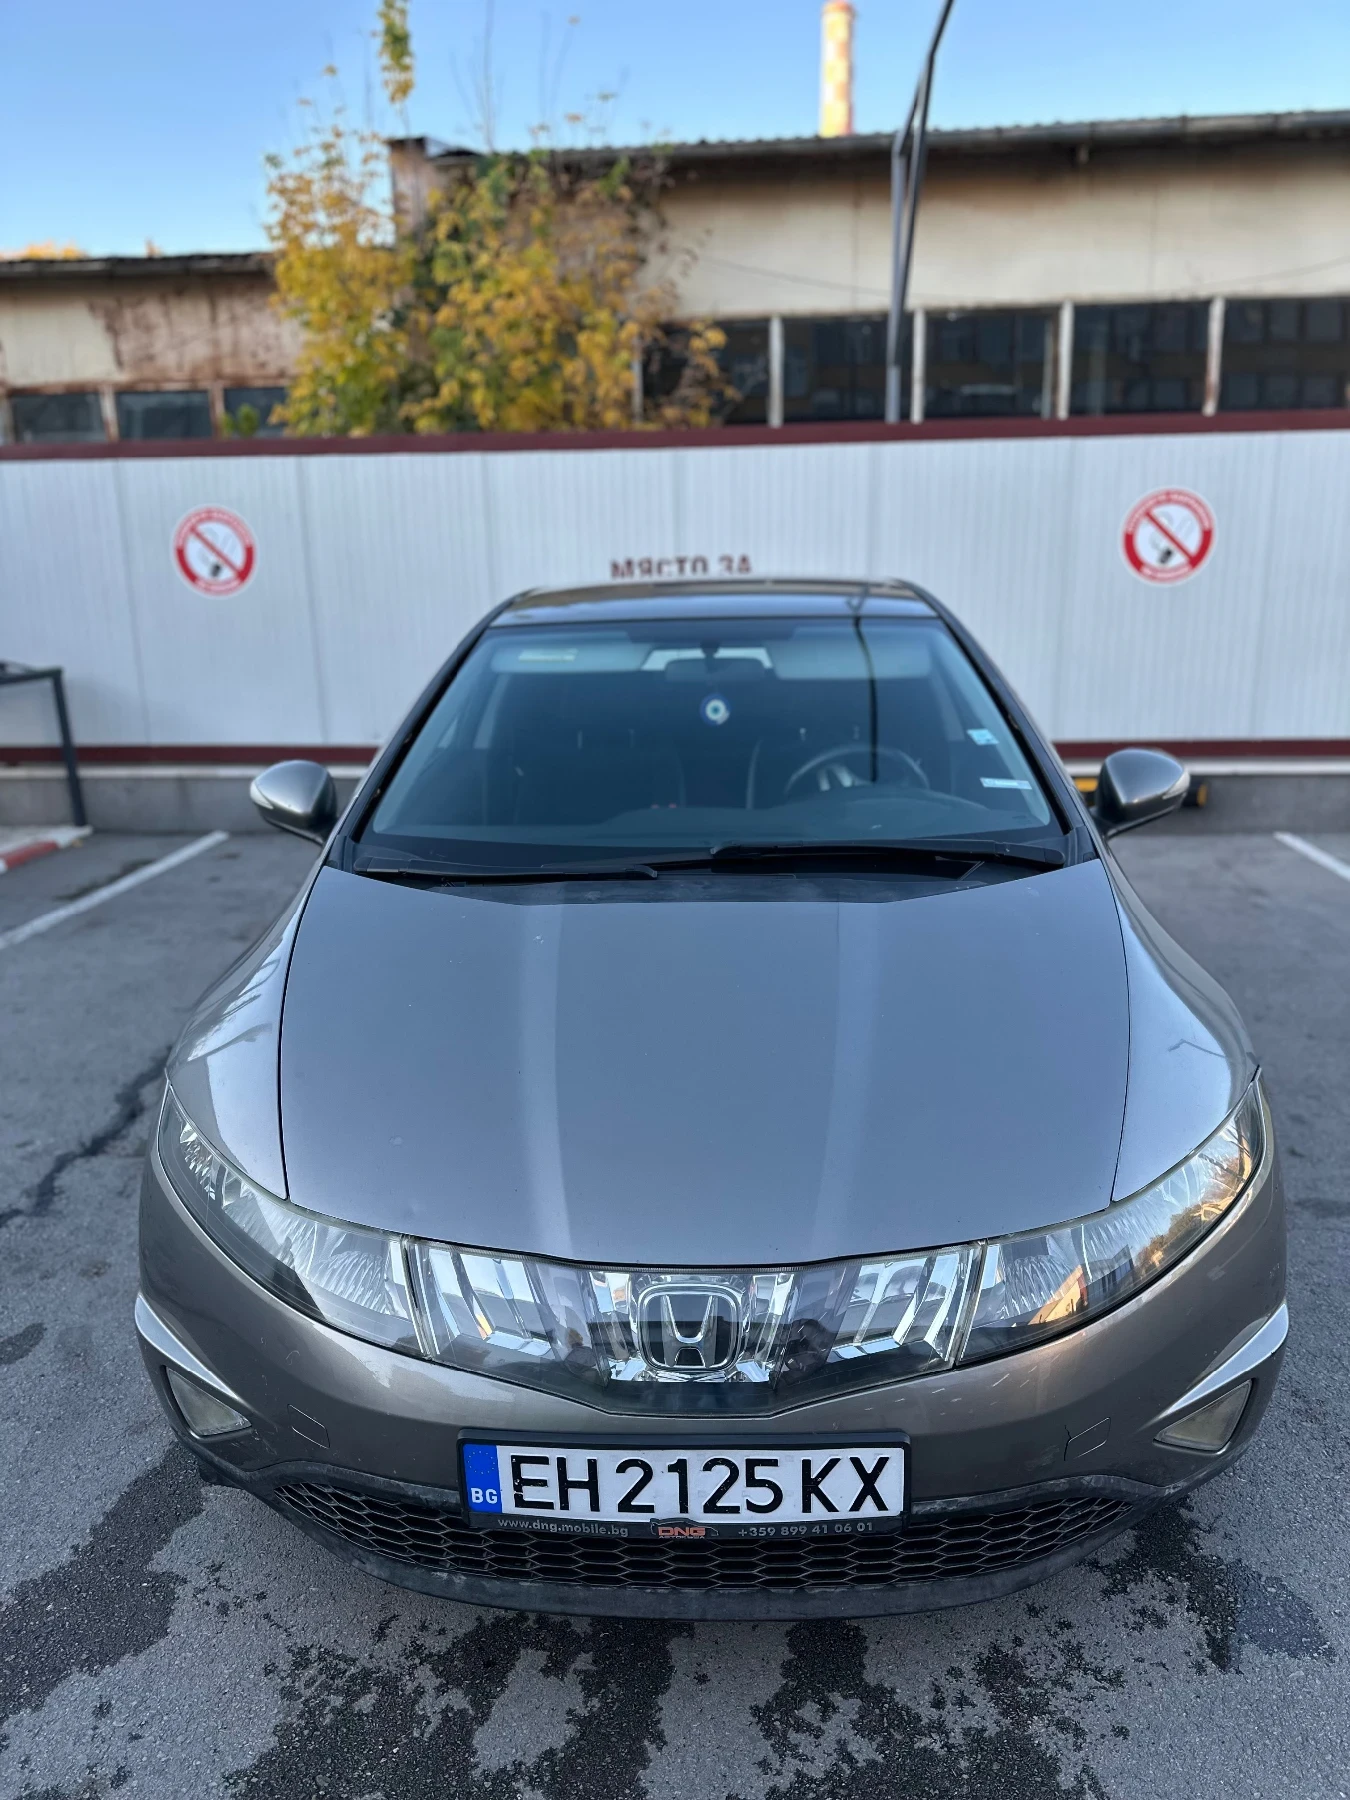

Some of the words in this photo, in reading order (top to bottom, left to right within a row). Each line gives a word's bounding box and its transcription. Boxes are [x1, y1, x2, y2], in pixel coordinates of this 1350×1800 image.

[616, 1458, 783, 1513] 2125
[471, 1488, 498, 1504] BG
[498, 1519, 628, 1537] www.dng.mobile.bg
[658, 1527, 706, 1536] DNG
[739, 1527, 776, 1537] +359
[780, 1526, 808, 1536] 899
[811, 1524, 828, 1534] 41
[834, 1523, 852, 1533] 06
[856, 1522, 873, 1532] 01
